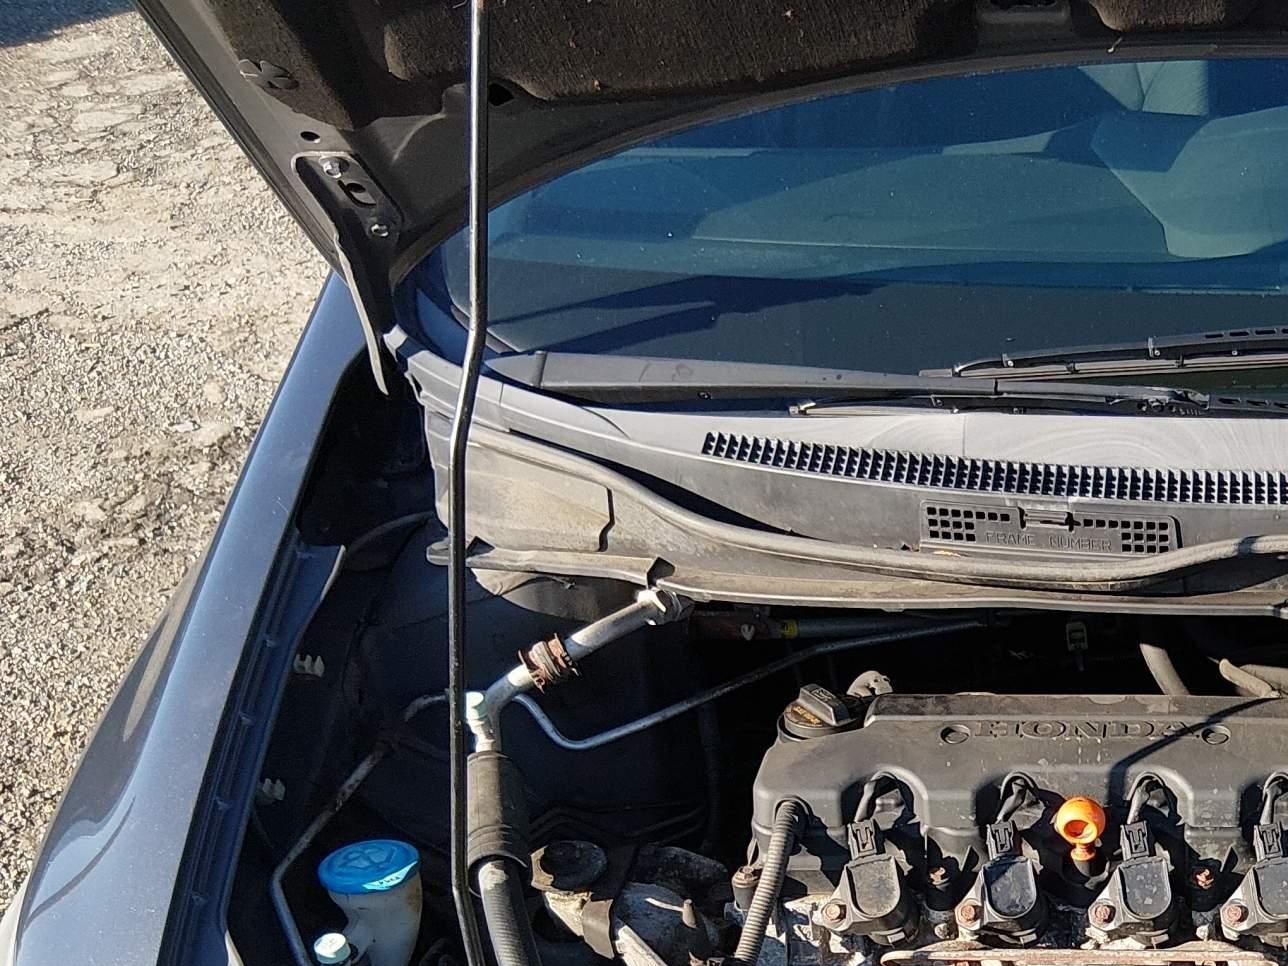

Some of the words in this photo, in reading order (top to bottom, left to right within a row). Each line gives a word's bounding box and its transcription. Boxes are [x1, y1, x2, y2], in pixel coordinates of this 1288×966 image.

[985, 530, 1036, 545] FRAME
[1049, 536, 1113, 552] NUMBER
[974, 720, 1199, 739] HONDA
